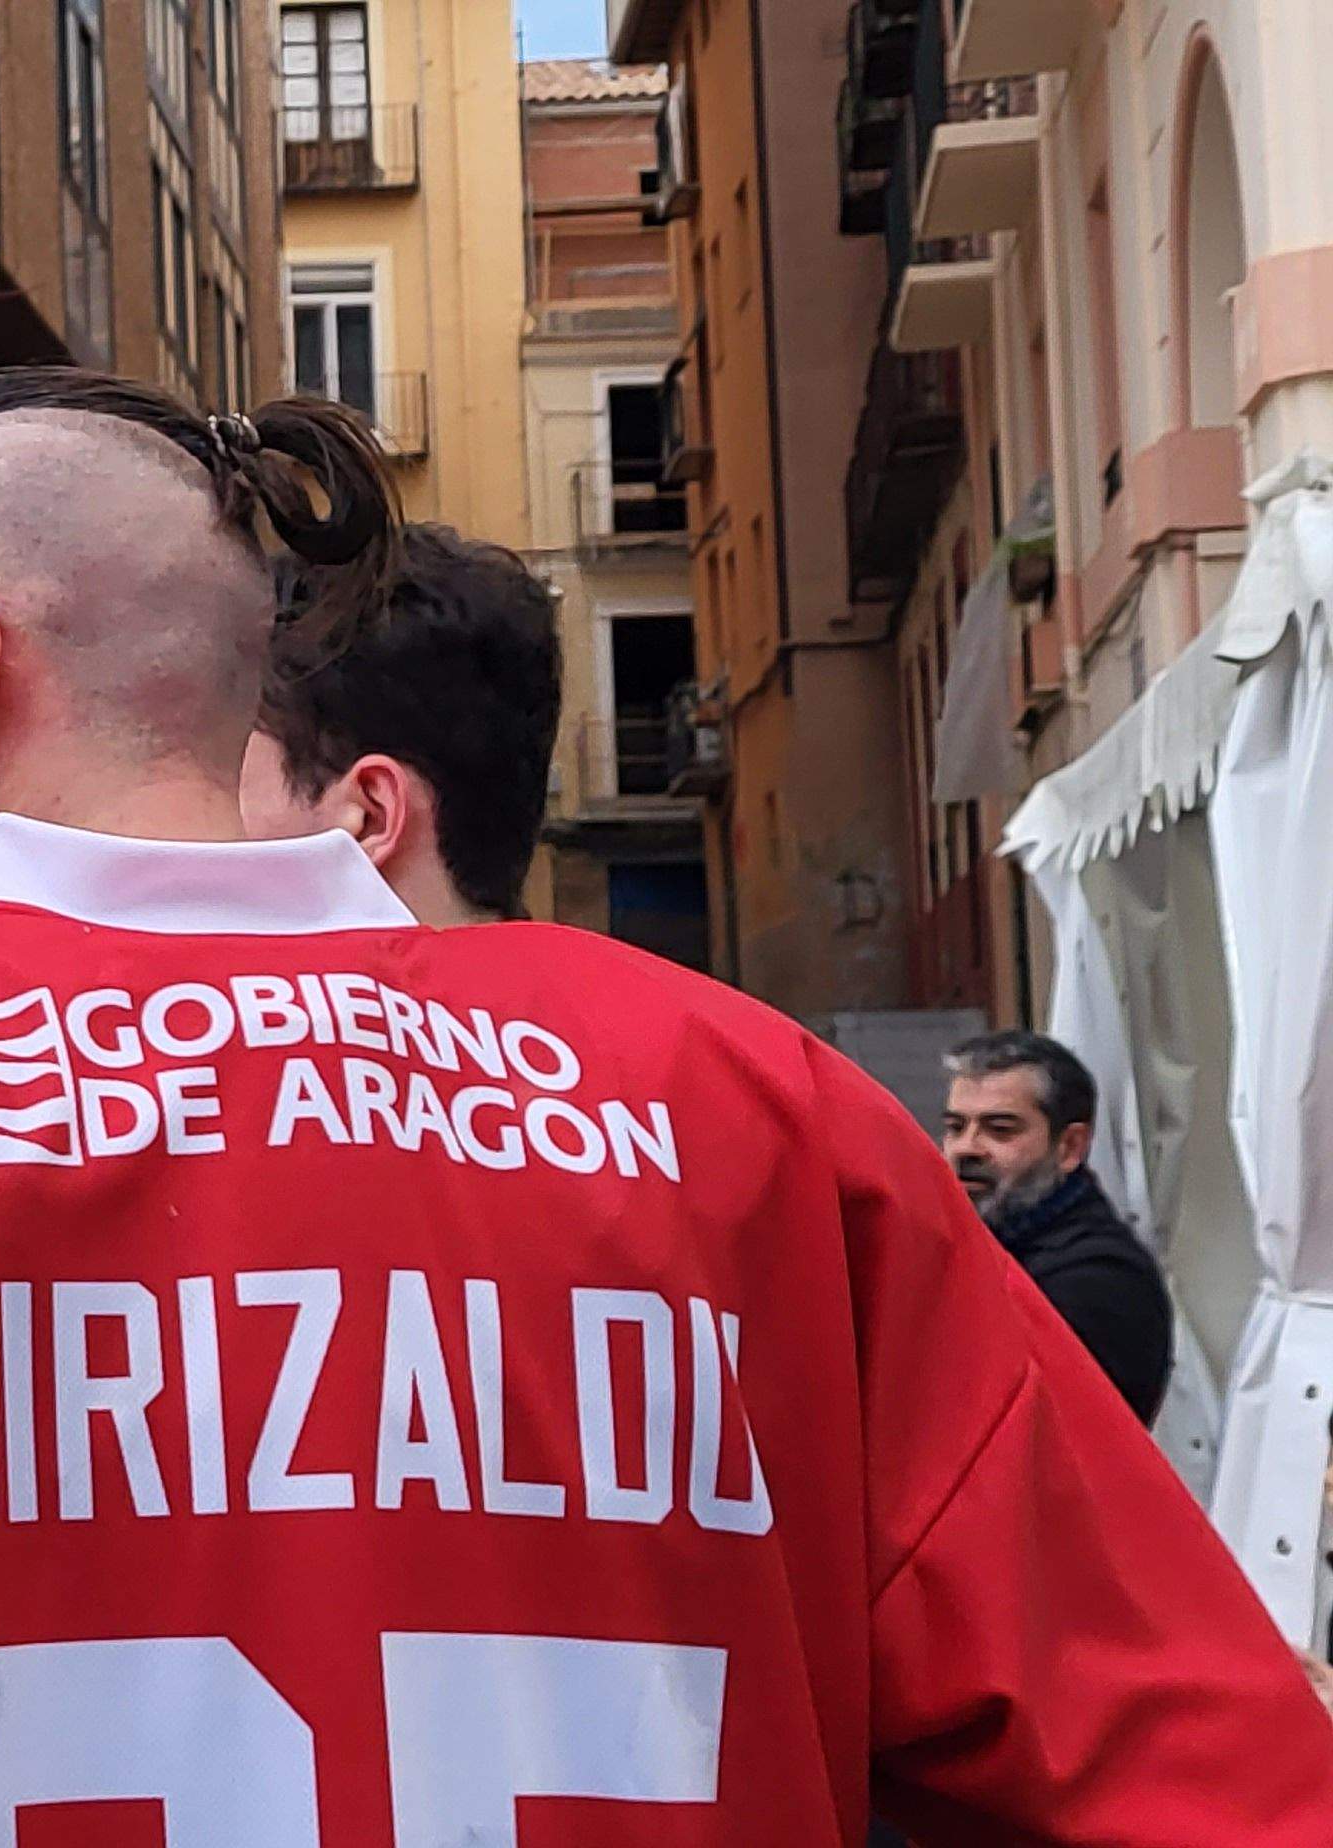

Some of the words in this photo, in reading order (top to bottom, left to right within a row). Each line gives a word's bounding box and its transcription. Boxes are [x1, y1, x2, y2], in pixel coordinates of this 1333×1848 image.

[65, 972, 581, 1092] GOBIERNO
[77, 1066, 227, 1158] DE
[267, 1056, 682, 1184] ARAGON
